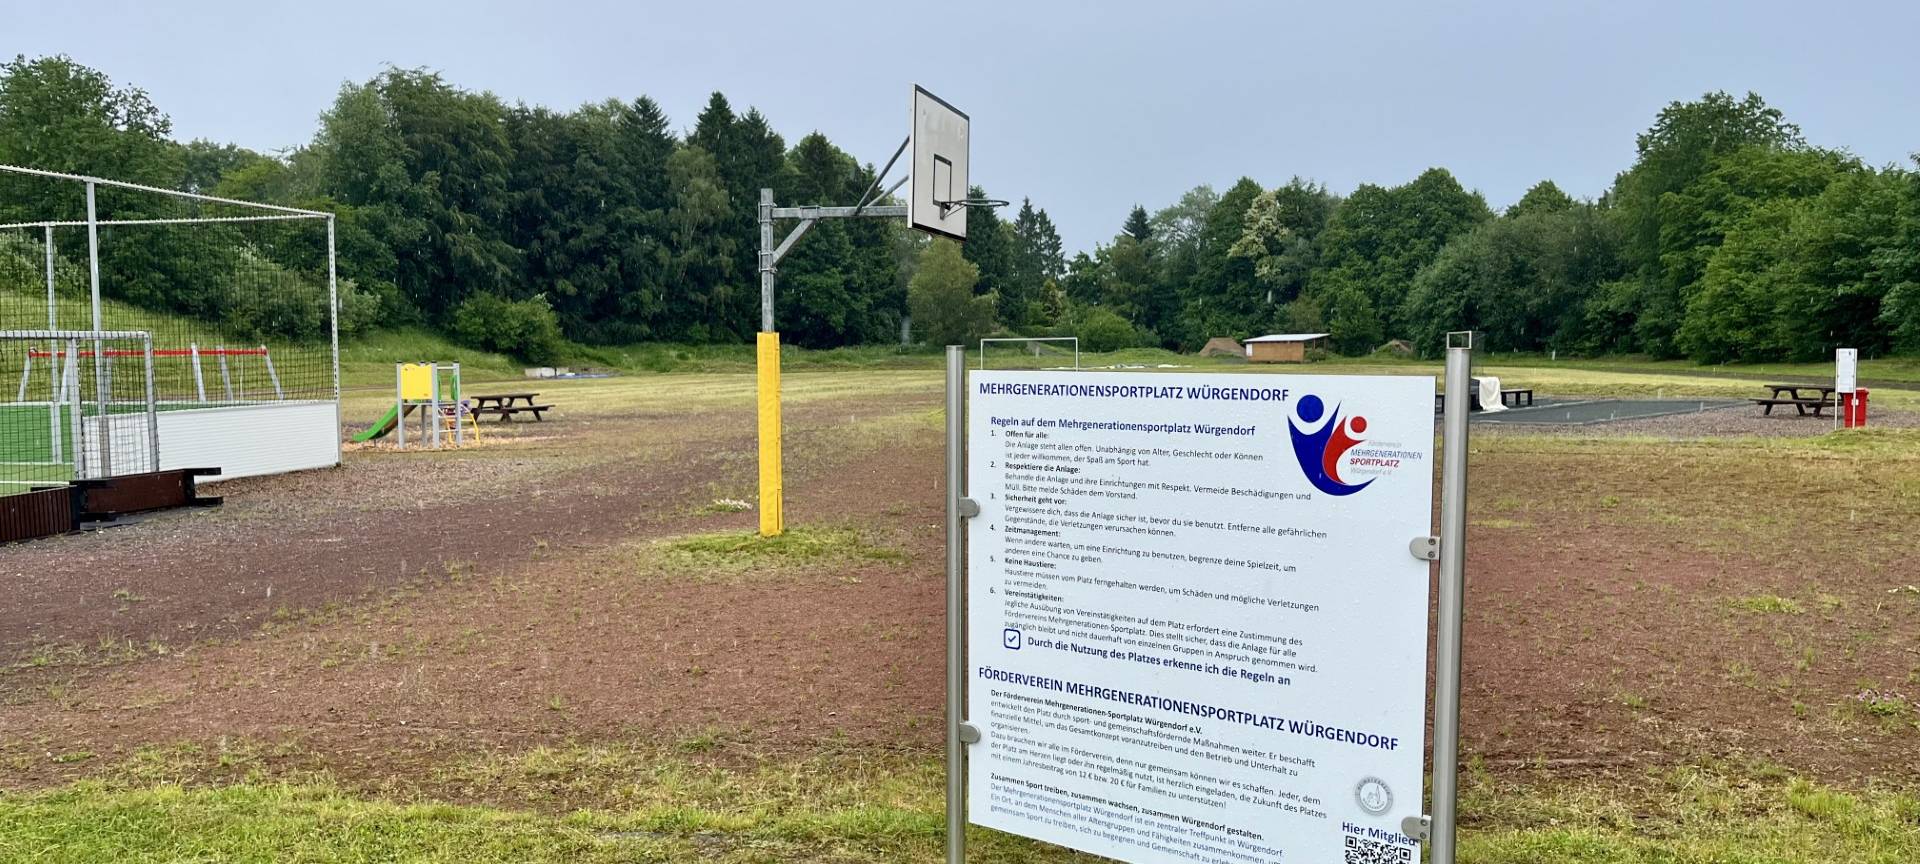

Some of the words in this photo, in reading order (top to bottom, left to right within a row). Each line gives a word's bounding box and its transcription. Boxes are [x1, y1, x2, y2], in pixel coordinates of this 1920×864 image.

[979, 384, 1183, 398] MEHRGENERATIONENSPORTPLATZ
[1187, 385, 1289, 401] WÜRGENDORF
[991, 416, 1018, 427] Regeln
[1021, 418, 1035, 426] auf
[1036, 418, 1056, 427] dem
[1058, 419, 1191, 434] Mehrgenerationensportplatz
[1194, 424, 1255, 436] Würgendorf
[1086, 456, 1103, 464] Spaß
[1116, 458, 1135, 466] Sport
[1095, 445, 1136, 455] Unabhängig
[1152, 448, 1170, 456] Alter,
[1172, 449, 1213, 457] Geschlecht
[1233, 452, 1263, 460] Können
[1350, 458, 1400, 468] SPORTPLATZ
[1351, 449, 1422, 460] MEHRGENERATIONEN
[1055, 465, 1080, 474] Anlage:
[1099, 479, 1146, 489] Einrichtungen
[1161, 483, 1191, 492] Respekt.
[1193, 485, 1229, 494] Vermeide
[1230, 488, 1293, 499] Beschädigungen
[1105, 491, 1137, 499] Vorstand.
[1091, 512, 1114, 521] Anlage
[1149, 516, 1170, 524] bevor
[1227, 523, 1260, 532] Entferne
[1277, 528, 1327, 537] gefährlichen
[1104, 525, 1146, 533] verursachen
[1147, 527, 1175, 536] können.
[1102, 546, 1140, 557] Einrichtung
[1151, 551, 1186, 561] benutzen,
[1188, 554, 1222, 564] begrenze
[1223, 558, 1245, 566] deine
[1246, 560, 1281, 571] Spielzeit,
[1094, 578, 1137, 589] ferngehalten
[1138, 585, 1167, 594] werden,
[1182, 588, 1213, 598] Schäden
[1230, 595, 1265, 604] mögliche
[1267, 598, 1319, 611] Verletzungen
[1047, 616, 1147, 635] Mehrgenerationen-Sportplatz.
[1148, 629, 1164, 638] Dies
[1165, 632, 1183, 640] stellt
[1184, 635, 1208, 645] sicher,
[1209, 638, 1226, 646] dass
[1227, 640, 1240, 648] die
[1241, 642, 1267, 653] Anlage
[1076, 609, 1135, 622] Vereinstätigkeiten
[1149, 618, 1166, 627] dem
[1167, 621, 1185, 629] Platz
[1186, 624, 1219, 634] erfordert
[1221, 628, 1237, 636] eine
[1239, 630, 1287, 645] Zustimmung
[1288, 637, 1302, 645] des
[1027, 637, 1052, 649] Durch
[1055, 641, 1068, 651] die
[1070, 644, 1108, 660] Nutzung
[1109, 650, 1125, 660] des
[1128, 652, 1160, 665] Platzes
[1162, 659, 1202, 672] erkenne
[1204, 664, 1219, 674] ich
[1221, 666, 1237, 677] die
[1240, 669, 1275, 683] Regeln
[1277, 677, 1290, 685] an
[1088, 632, 1122, 643] dauerhaft
[1137, 640, 1171, 650] einzelnen
[1172, 644, 1204, 656] Gruppen
[1214, 650, 1250, 662] Anspruch
[1251, 657, 1296, 668] genommen
[1297, 663, 1317, 672] wird.
[979, 666, 1062, 691] FÖRDERVEREIN
[1066, 682, 1284, 730] MEHRGENERATIONENSPORTPLATZ
[1288, 720, 1398, 750] WÜRGENDORF
[990, 689, 1002, 697] Der
[1044, 699, 1143, 723] Mehrgenerationen-Sportplatz
[1144, 717, 1187, 731] Würgendorf
[1068, 725, 1119, 742] Gesamtkonzept
[1121, 737, 1173, 751] voranzutreiben
[1189, 748, 1204, 757] den
[1205, 751, 1233, 762] Betrieb
[1234, 758, 1249, 766] und
[1250, 760, 1287, 773] Unterhalt
[1107, 723, 1191, 743] gemeinschaftsfördernde
[1192, 737, 1240, 752] Maßnahmen
[1268, 751, 1276, 759] Er
[1279, 753, 1315, 766] beschafft
[1070, 747, 1114, 763] Förderverein,
[1115, 756, 1133, 766] denn
[1147, 764, 1188, 777] gemeinsam
[1189, 771, 1217, 783] können
[1278, 789, 1300, 801] Jeder,
[1302, 794, 1320, 804] dem
[1096, 765, 1133, 779] regelmäßig
[1134, 773, 1154, 782] nutzt,
[1165, 778, 1194, 790] herzlich
[1195, 785, 1237, 800] eingeladen,
[1239, 793, 1251, 802] die
[1252, 796, 1282, 808] Zukunft
[1283, 803, 1297, 812] des
[1299, 806, 1327, 818] Platzes
[1110, 777, 1119, 785] 20
[1137, 783, 1167, 795] Familien
[1178, 793, 1226, 808] unterstützen!
[1044, 785, 1069, 797] treiben,
[1070, 792, 1106, 805] zusammen
[1107, 800, 1140, 813] wachsen,
[1141, 808, 1179, 821] zusammen
[1181, 815, 1225, 832] Würgendorf
[1226, 827, 1264, 840] gestalten.
[1342, 821, 1366, 835] Hier
